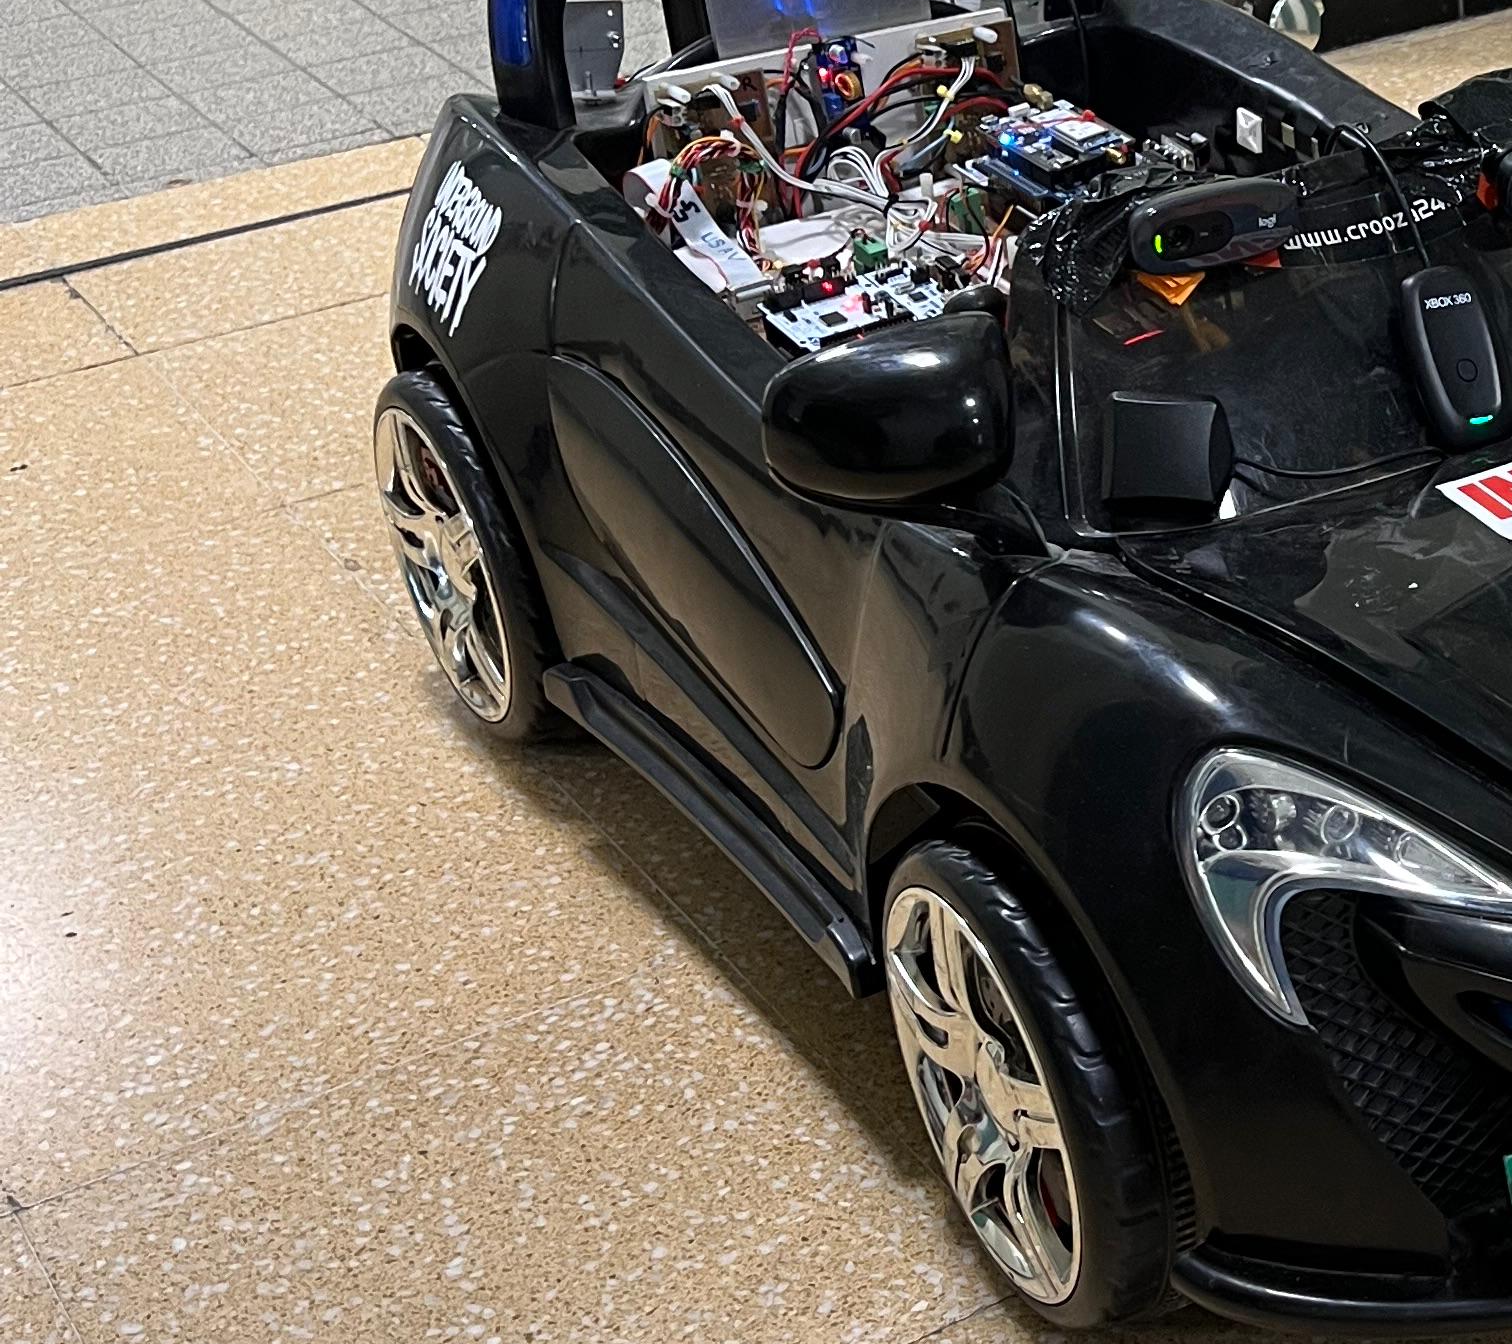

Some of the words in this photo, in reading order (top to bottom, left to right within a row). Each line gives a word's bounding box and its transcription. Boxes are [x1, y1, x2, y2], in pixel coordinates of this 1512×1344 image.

[408, 207, 487, 338] SOCIETY
[1423, 295, 1454, 310] XBOX
[1453, 292, 1472, 305] 360
